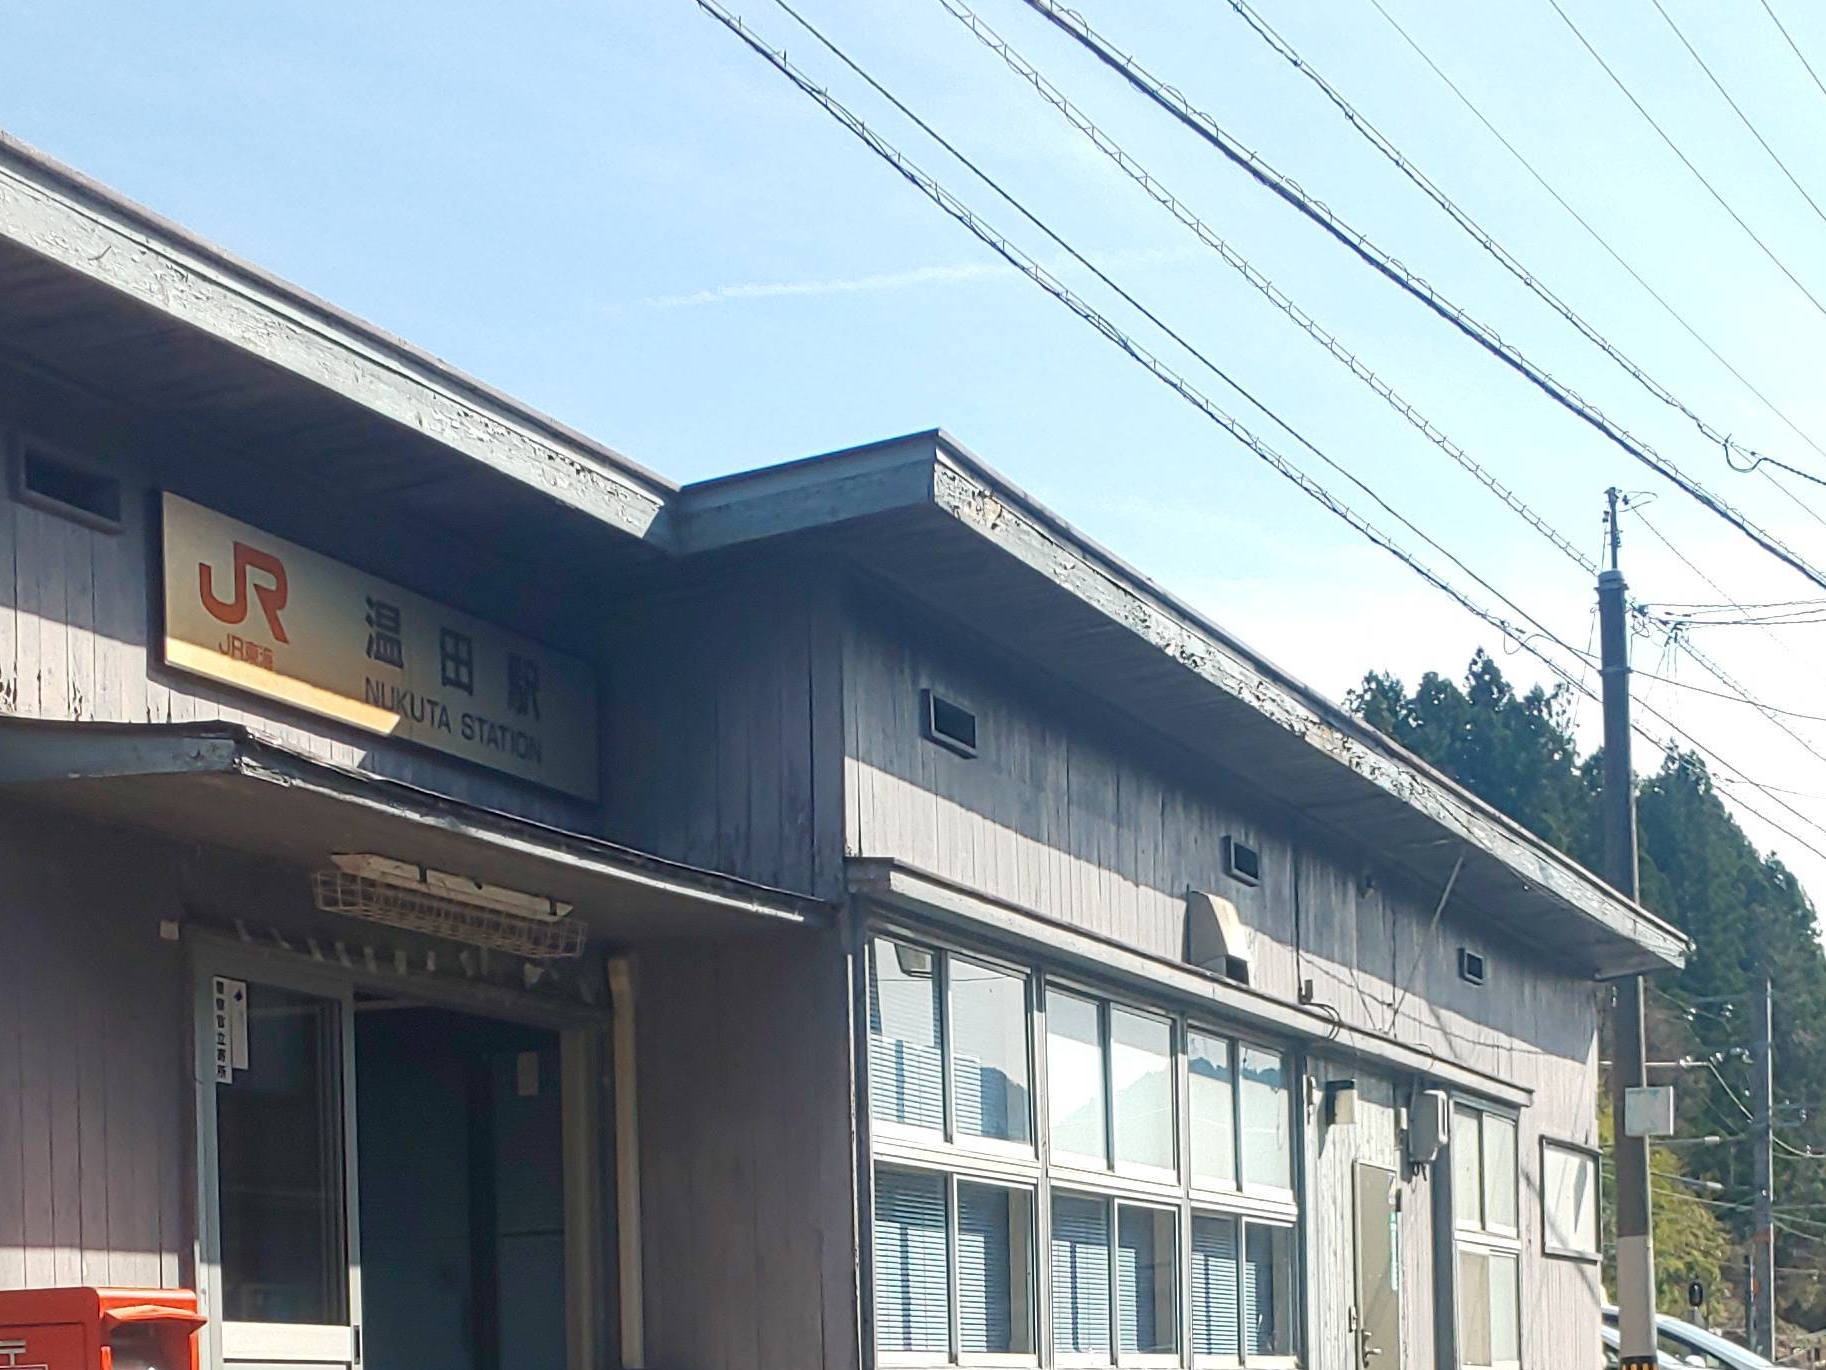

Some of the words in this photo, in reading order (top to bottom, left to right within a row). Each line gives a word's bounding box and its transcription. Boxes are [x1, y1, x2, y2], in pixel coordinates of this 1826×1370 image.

[199, 541, 289, 645] JR
[365, 596, 540, 722] 温田駅
[365, 677, 452, 734] NUKUTA
[461, 712, 542, 764] STATION
[216, 980, 227, 1079] 官立寄所
